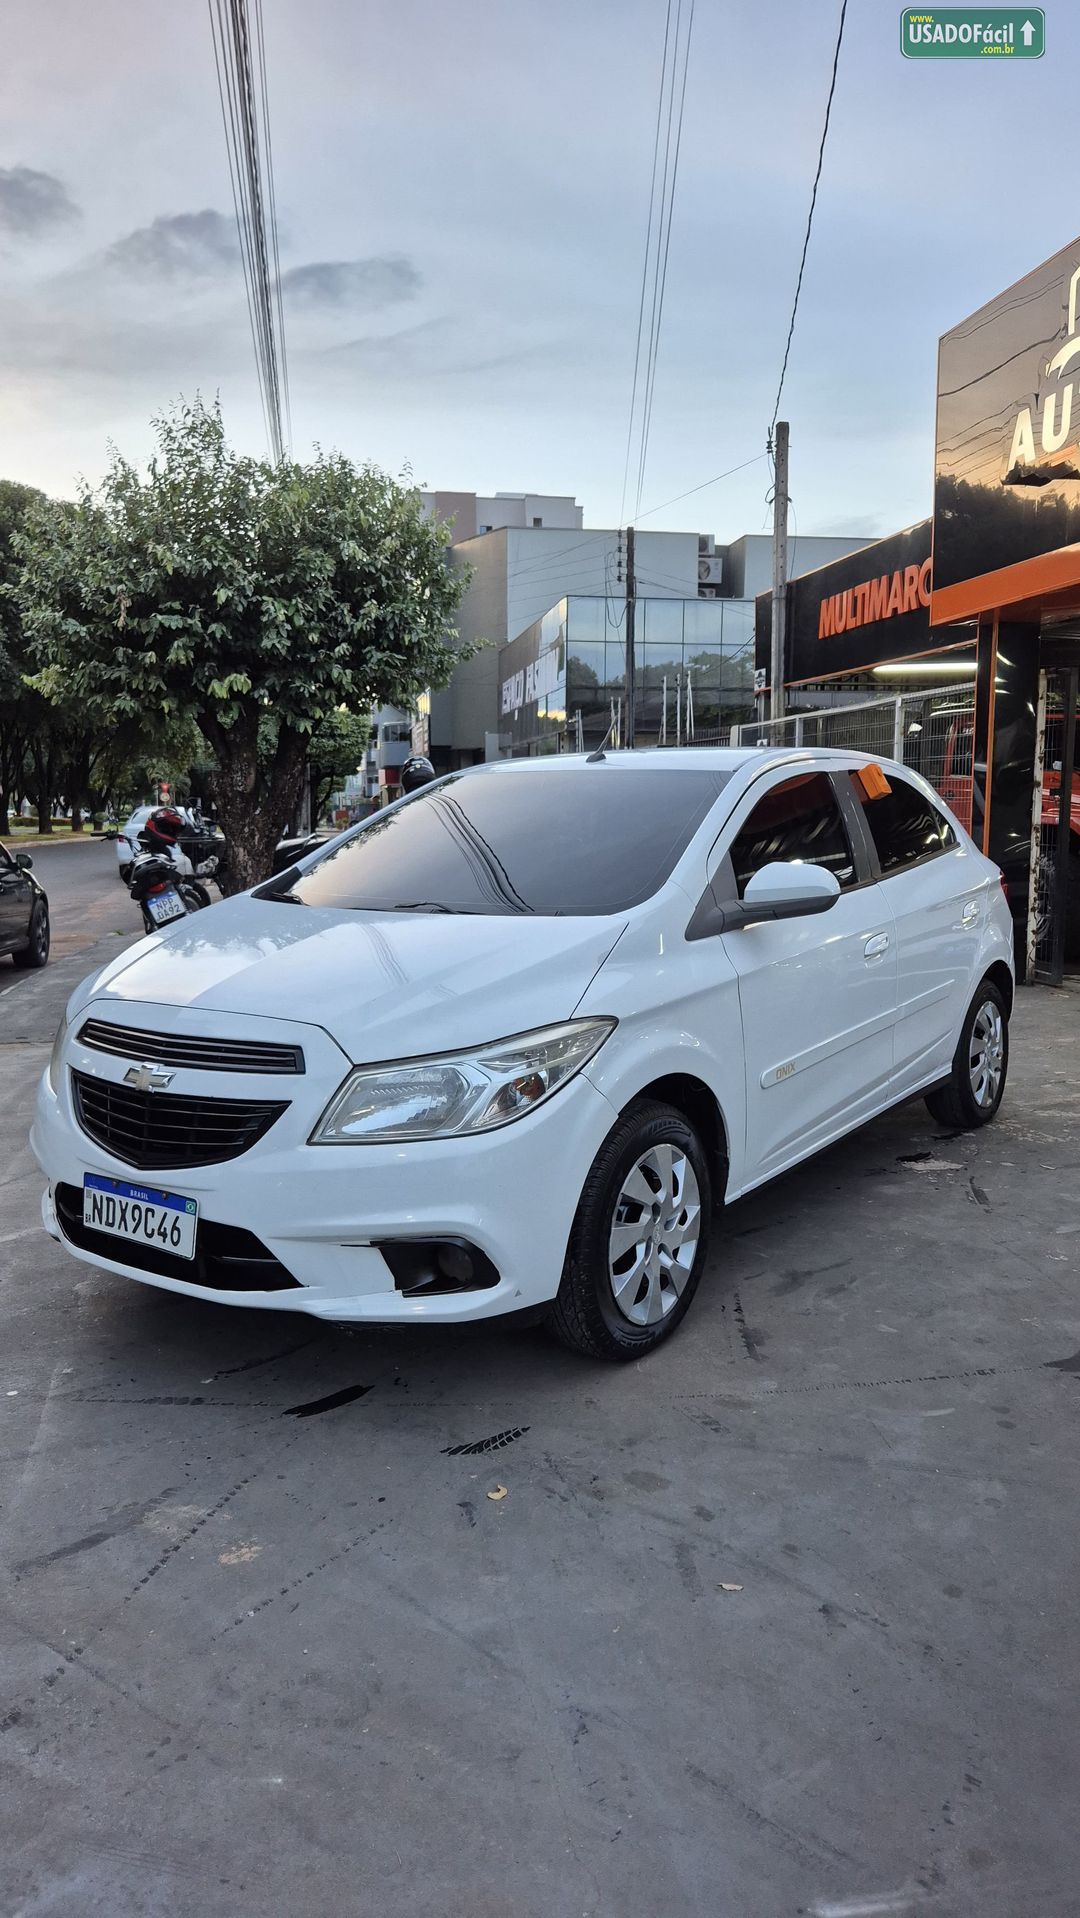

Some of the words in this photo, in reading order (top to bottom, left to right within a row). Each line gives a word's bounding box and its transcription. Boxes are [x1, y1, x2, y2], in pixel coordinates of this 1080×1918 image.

[1004, 384, 1080, 473] AU
[775, 1061, 796, 1080] ONIX
[129, 1189, 149, 1201] BRASIL
[92, 1193, 182, 1247] NDX9C46
